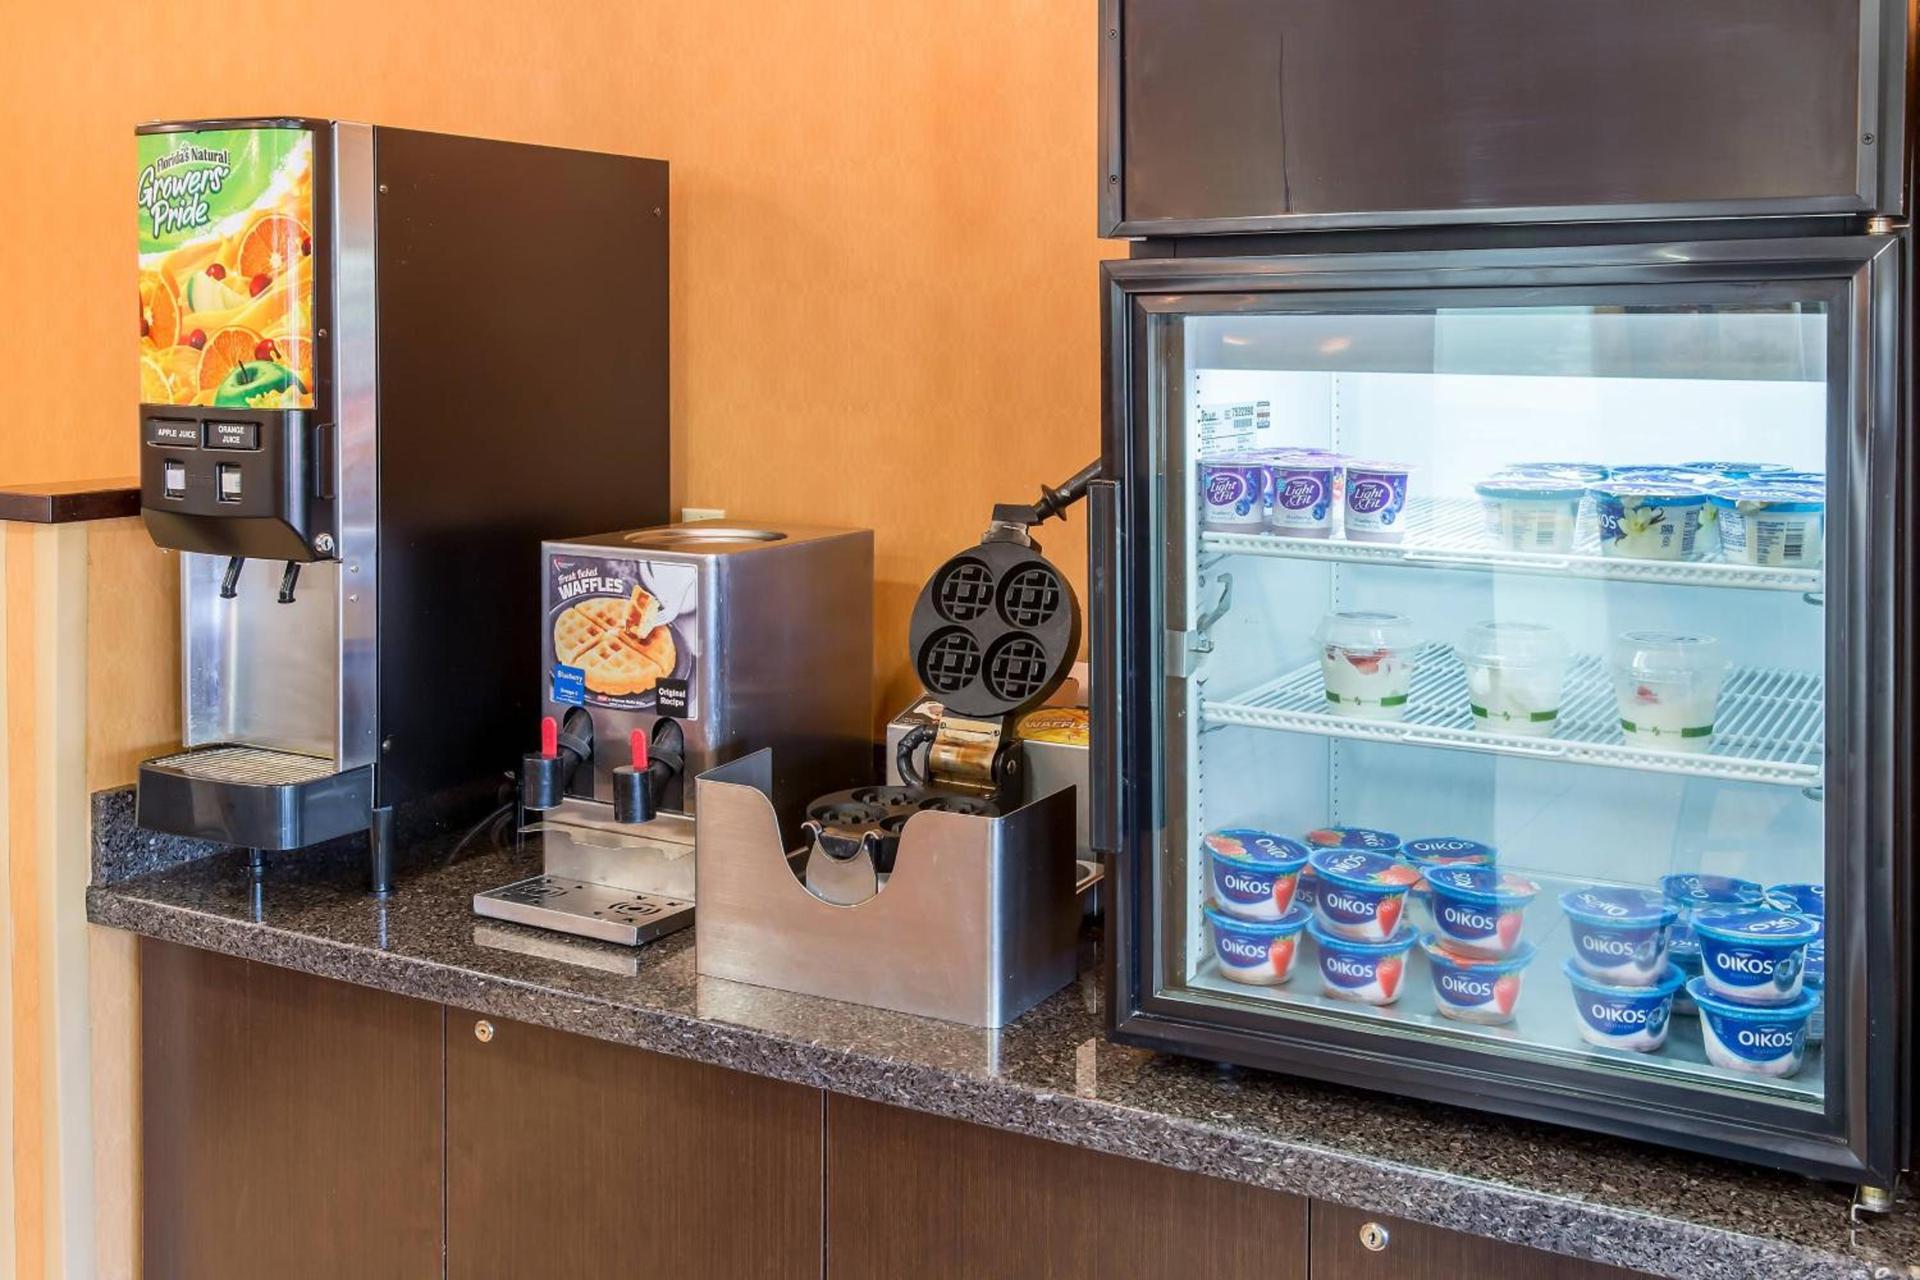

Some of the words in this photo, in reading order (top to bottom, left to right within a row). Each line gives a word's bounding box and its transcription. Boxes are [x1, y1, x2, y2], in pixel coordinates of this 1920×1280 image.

[191, 148, 228, 165] Natural
[151, 193, 210, 239] Pride
[158, 428, 177, 438] APPLE
[179, 429, 196, 439] JUICE
[218, 425, 244, 435] ORANGE
[222, 435, 240, 444] JUICE
[1211, 479, 1237, 495] Light
[1285, 482, 1315, 497] Light
[1355, 486, 1385, 501] Light
[558, 577, 624, 600] WAFFLES
[658, 687, 686, 698] Original
[660, 697, 684, 707] Recipe
[1413, 841, 1476, 851] OIKOS
[1225, 874, 1272, 896] OIKOS
[1327, 894, 1375, 916] OIKOS
[1445, 907, 1495, 931] OIKOS
[1222, 938, 1267, 959] OIKOS
[1582, 935, 1634, 957] OIKOS
[1326, 957, 1374, 978] OIKOS
[1717, 953, 1773, 975] OIKOS
[1442, 974, 1492, 997] OIKOS
[1592, 1004, 1647, 1024] OIKOS
[1738, 1030, 1793, 1048] OIKOS
